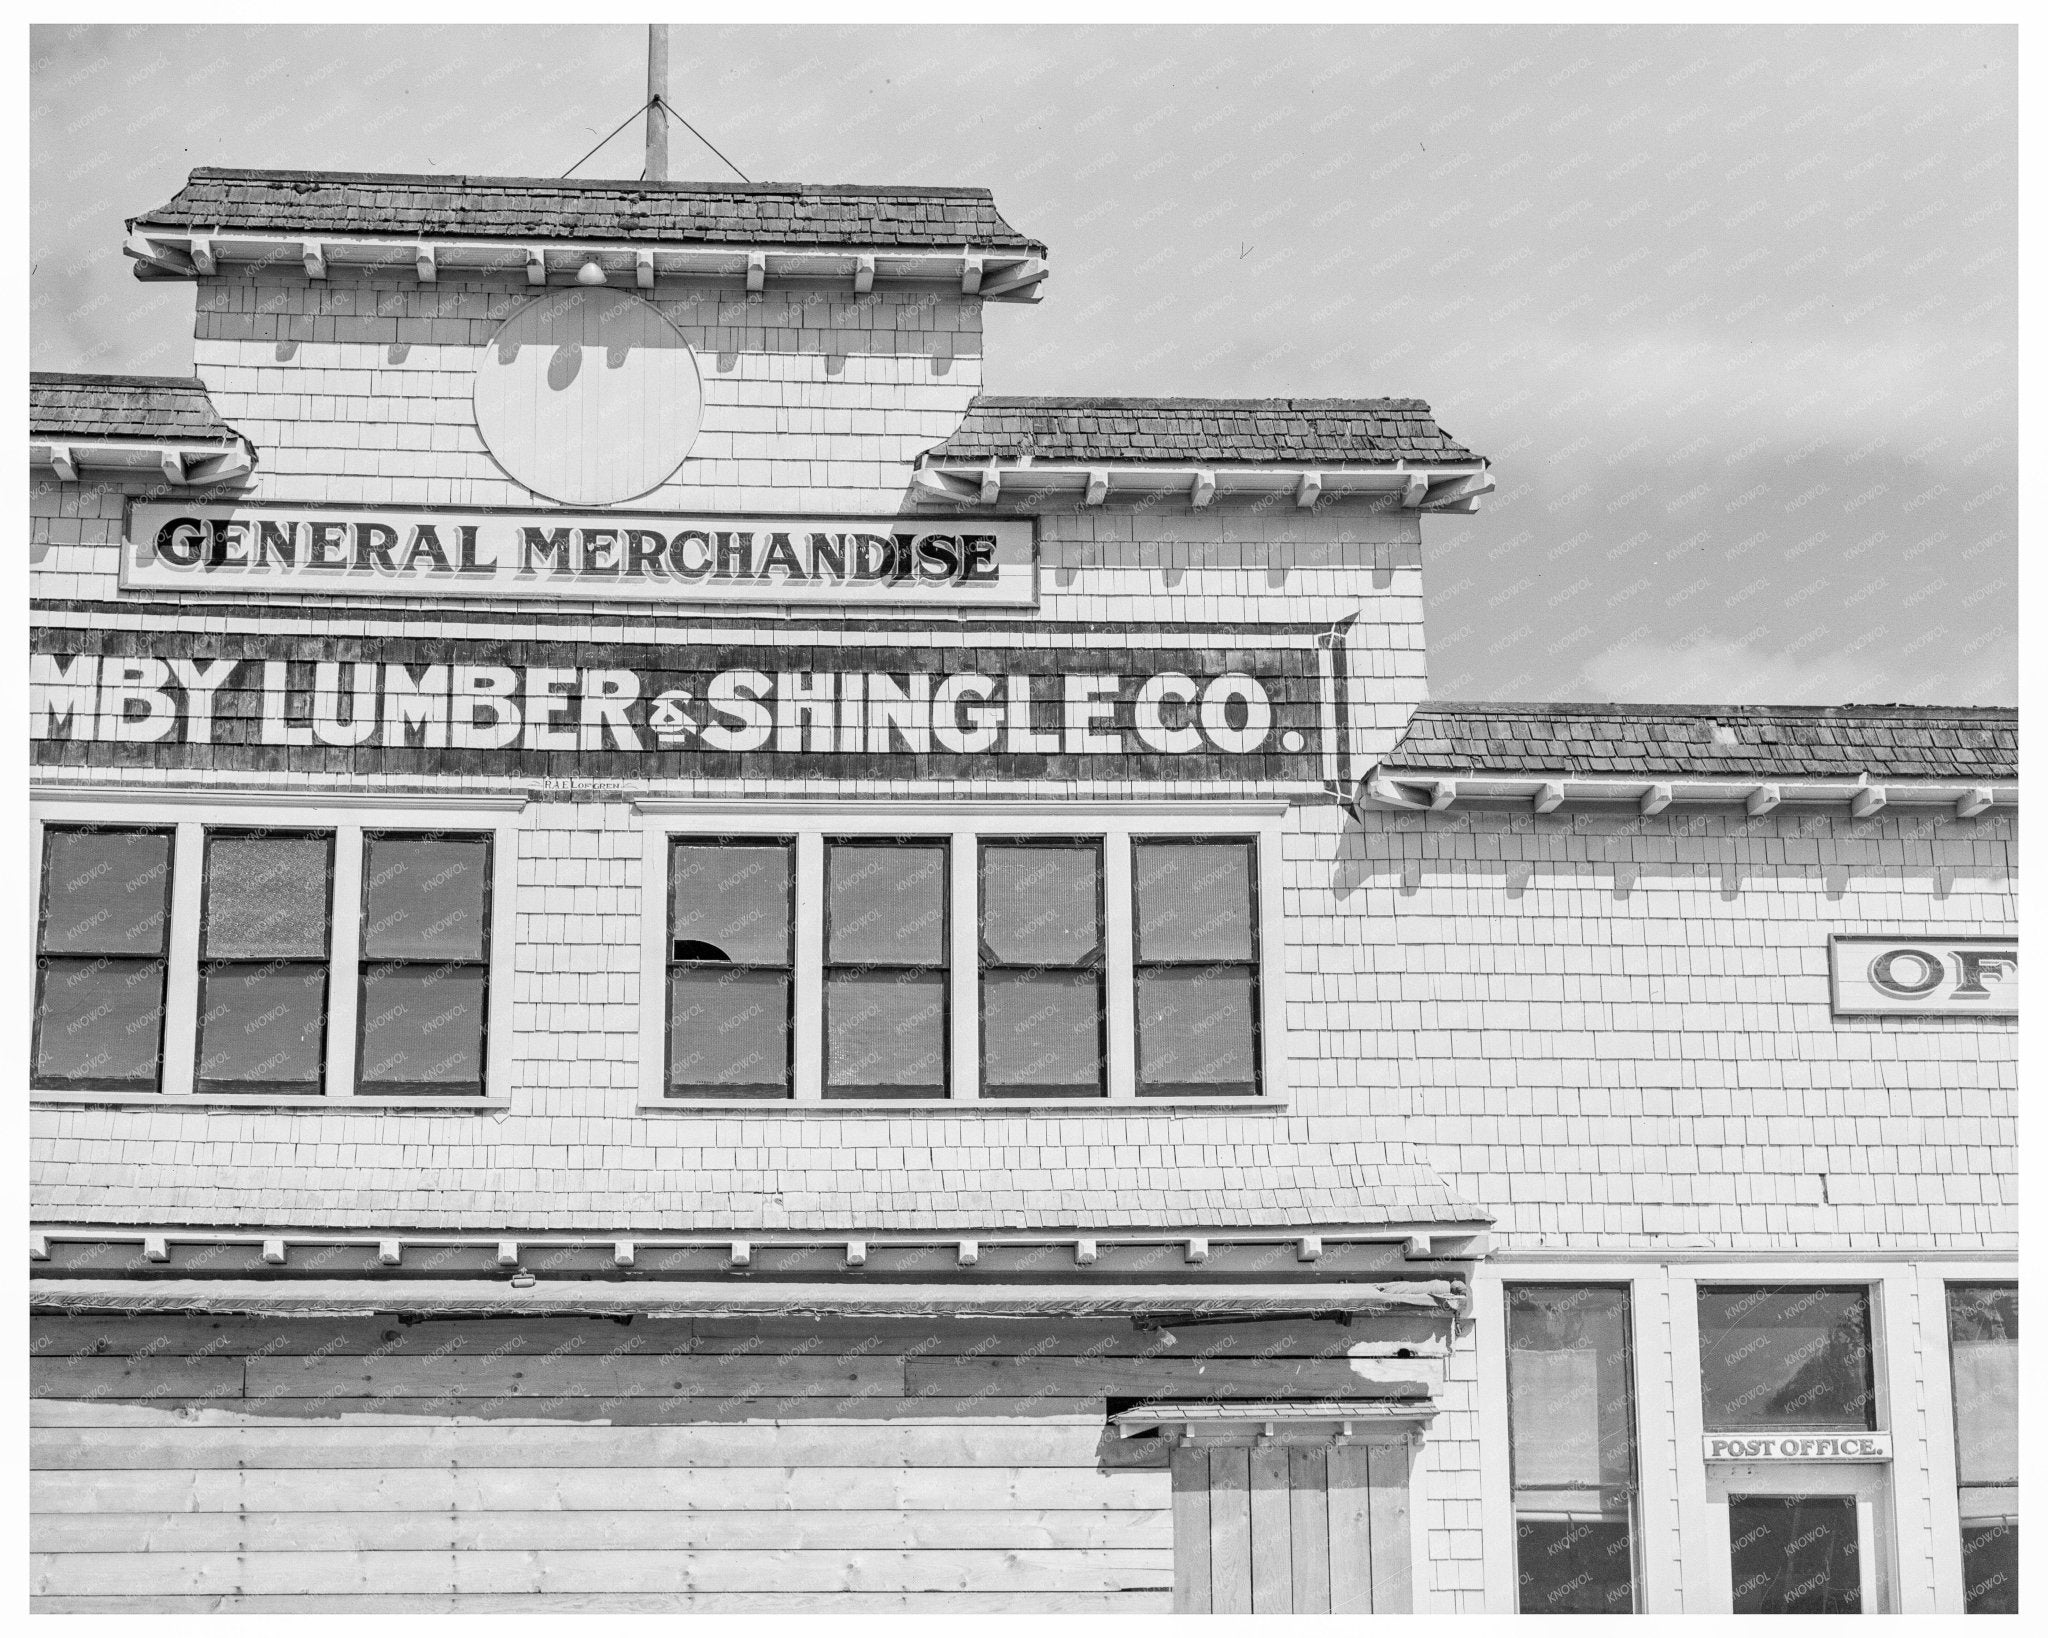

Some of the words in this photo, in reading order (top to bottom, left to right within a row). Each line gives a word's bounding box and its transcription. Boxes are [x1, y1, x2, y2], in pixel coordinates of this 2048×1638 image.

[152, 517, 497, 580] GENERAL
[515, 525, 1000, 588] MERCHANDISE
[262, 660, 643, 751] LUMBER
[650, 690, 697, 742] &
[700, 669, 1122, 754] SHINGLE
[1134, 671, 1304, 754] CO.
[1867, 949, 2018, 1001] OF
[1711, 1438, 1776, 1457] POST
[1780, 1438, 1884, 1457] OFFICE.
